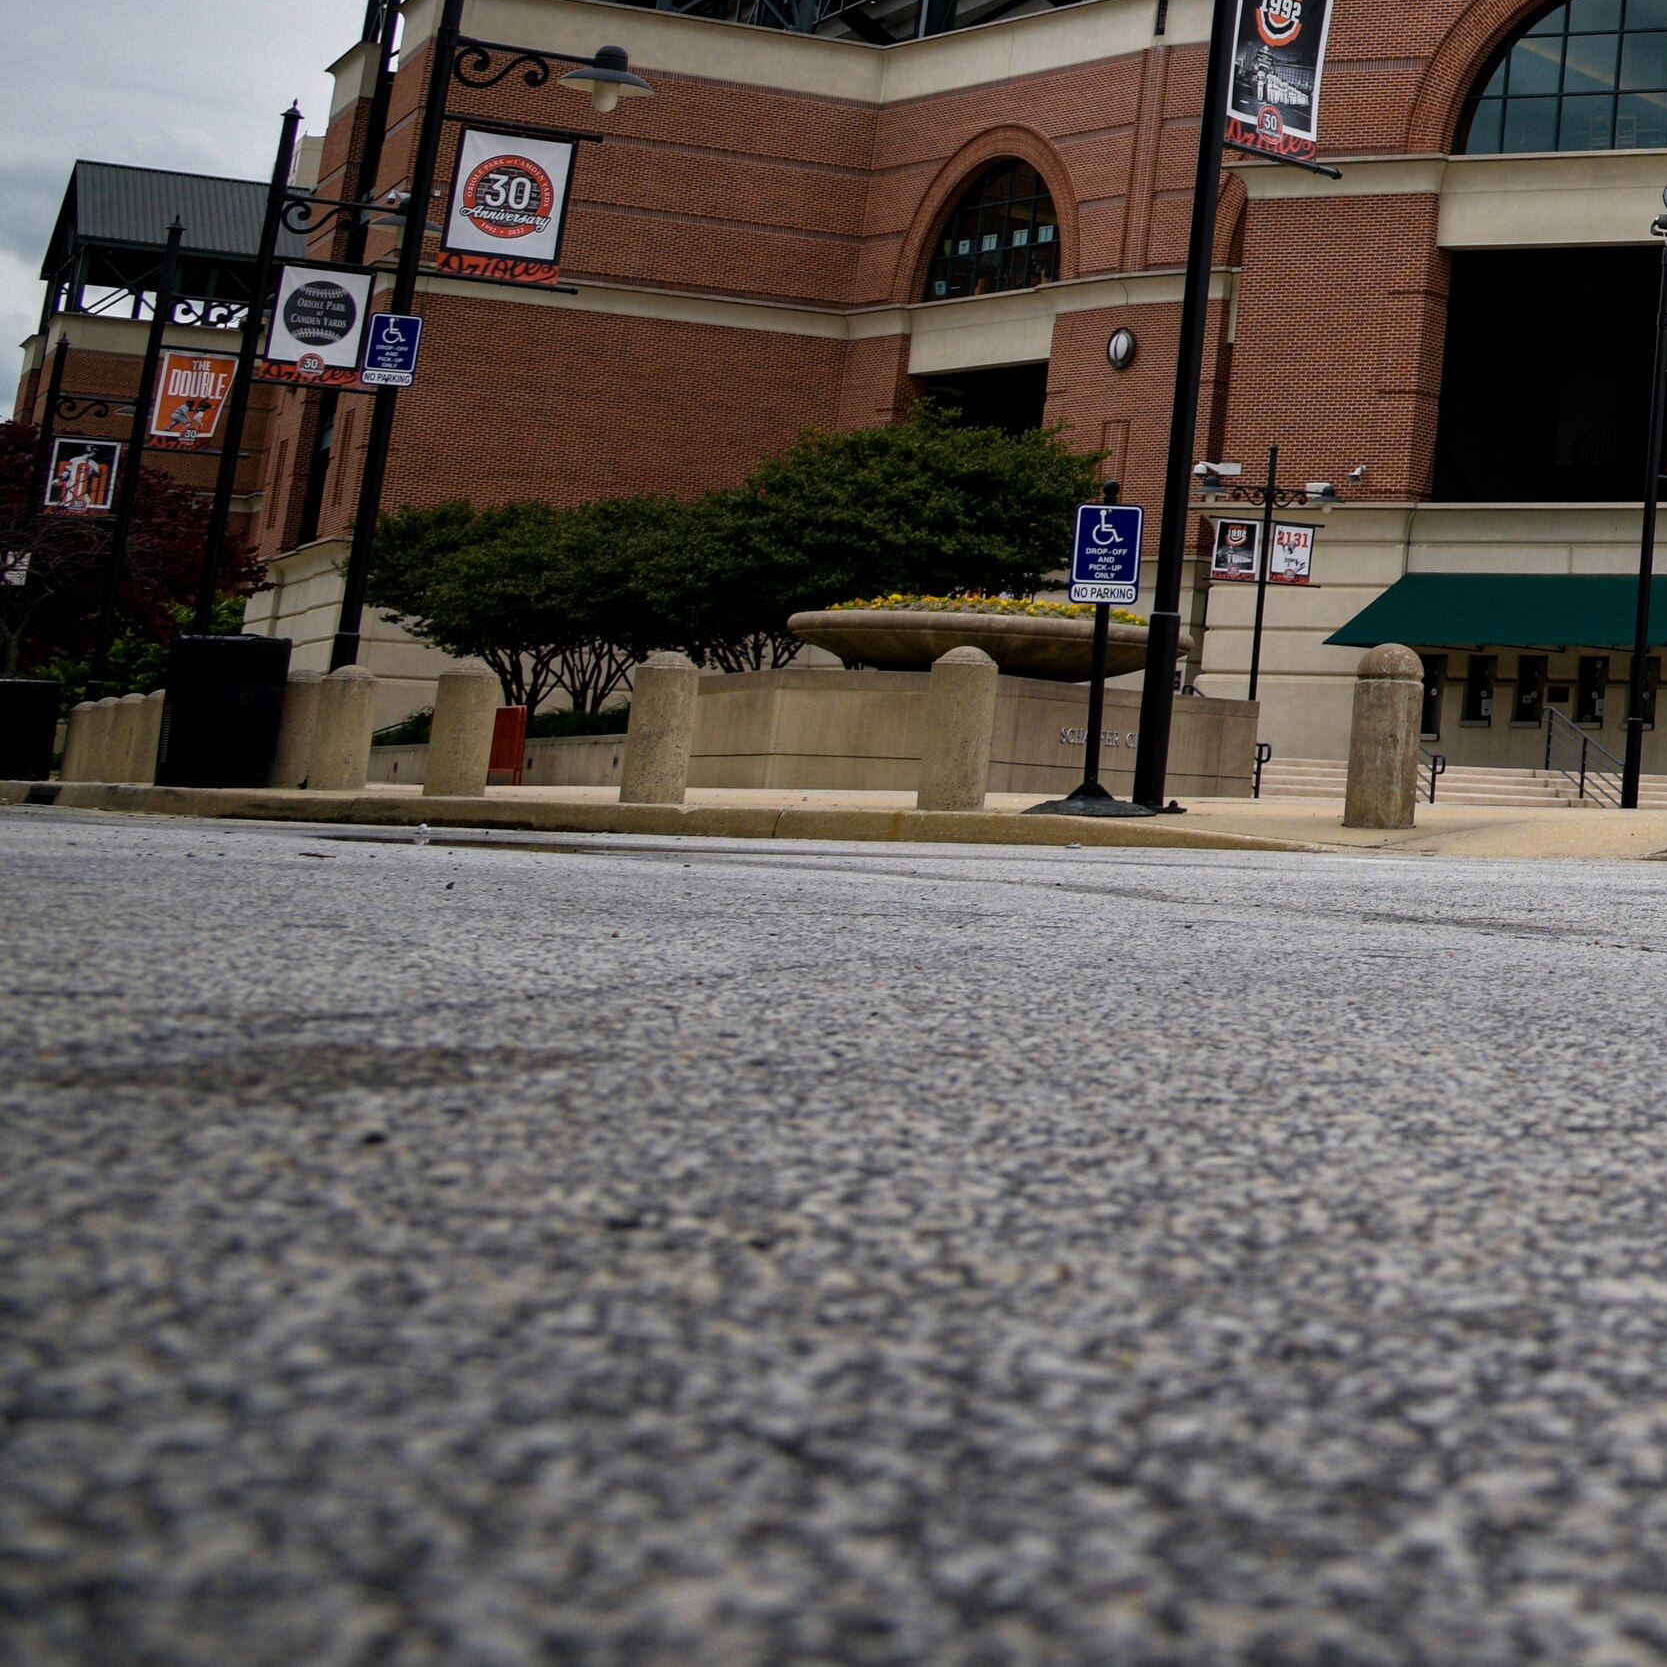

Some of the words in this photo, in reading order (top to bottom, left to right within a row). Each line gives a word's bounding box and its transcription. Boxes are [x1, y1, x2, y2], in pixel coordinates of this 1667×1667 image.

[1263, 113, 1277, 131] 30
[484, 159, 504, 173] PARK
[514, 159, 545, 181] CAMDEN
[485, 173, 531, 210] 30
[461, 205, 551, 232] Anniversary
[297, 297, 324, 310] ORIOLE
[326, 300, 346, 312] PARK
[290, 313, 321, 326] CAMDEN
[323, 316, 347, 328] YARDS
[376, 344, 408, 352] DROP-OFF
[192, 361, 211, 371] THE
[304, 358, 318, 369] 30
[168, 369, 228, 400] DOUBLE
[364, 373, 375, 381] NO
[377, 374, 411, 383] PARKING
[184, 430, 197, 439] 30
[1277, 530, 1309, 548] 2131
[1085, 548, 1128, 556] DROP-OFF
[1073, 586, 1088, 598] NO
[1090, 587, 1133, 600] PARKING
